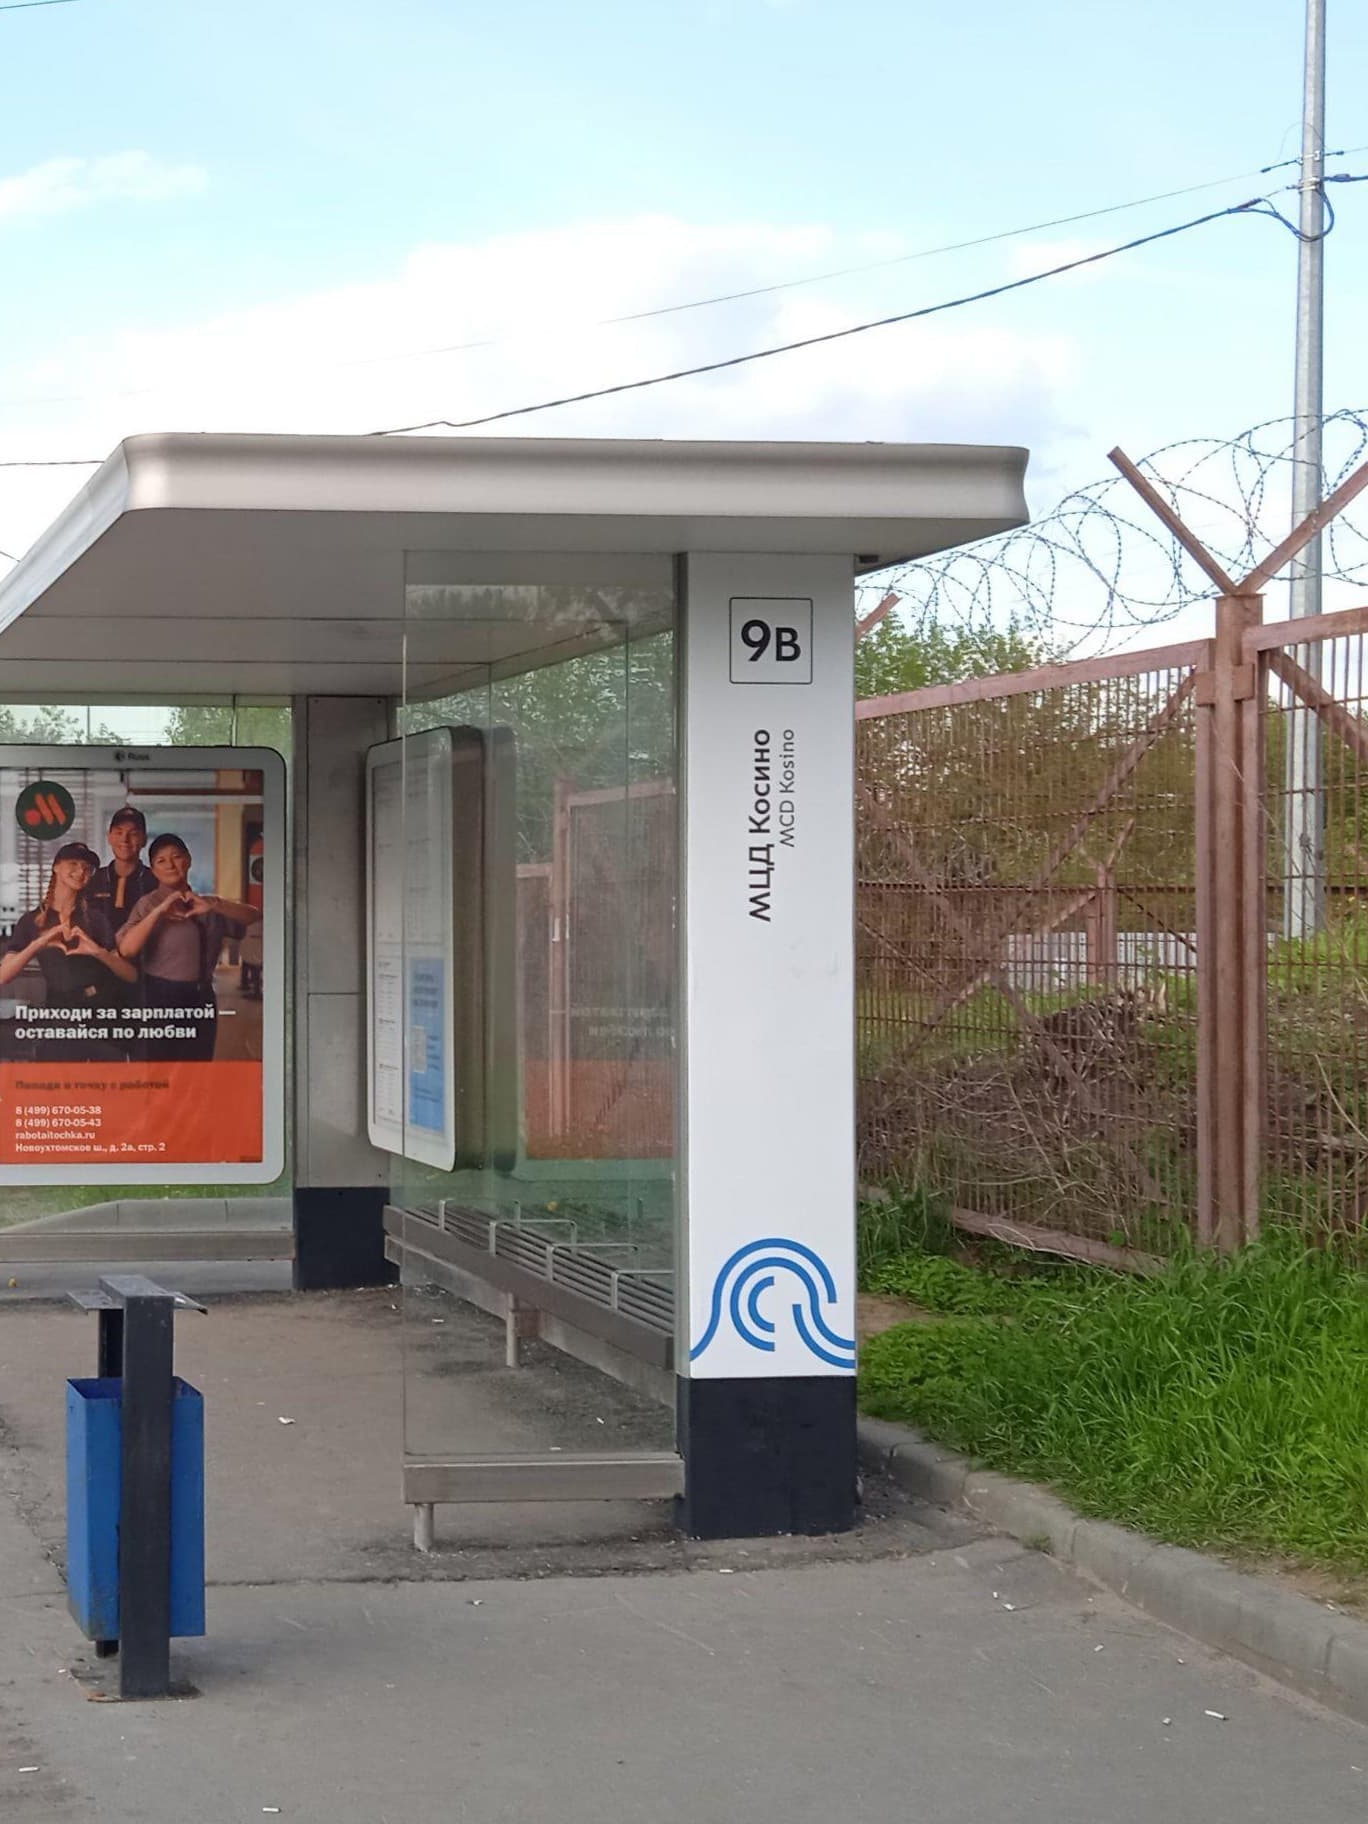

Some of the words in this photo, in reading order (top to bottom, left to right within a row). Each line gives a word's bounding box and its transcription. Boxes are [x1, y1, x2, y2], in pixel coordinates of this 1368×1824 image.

[779, 728, 795, 794] Kosino
[748, 729, 771, 834] Косино
[779, 799, 795, 848] MCD
[748, 844, 775, 922] МЦД
[15, 1005, 92, 1021] Приходи
[96, 1008, 117, 1019] за
[121, 1004, 215, 1021] зарплатой
[15, 1024, 109, 1039] оставайся
[112, 1028, 134, 1038] по
[137, 1025, 197, 1038] любви
[15, 1106, 22, 1115] 8
[24, 1106, 50, 1116] (499)
[52, 1106, 102, 1115] 670-05-38
[15, 1118, 22, 1127] 8
[24, 1118, 50, 1128] (499)
[52, 1118, 102, 1127] 670-05-43
[158, 1142, 166, 1152] 2
